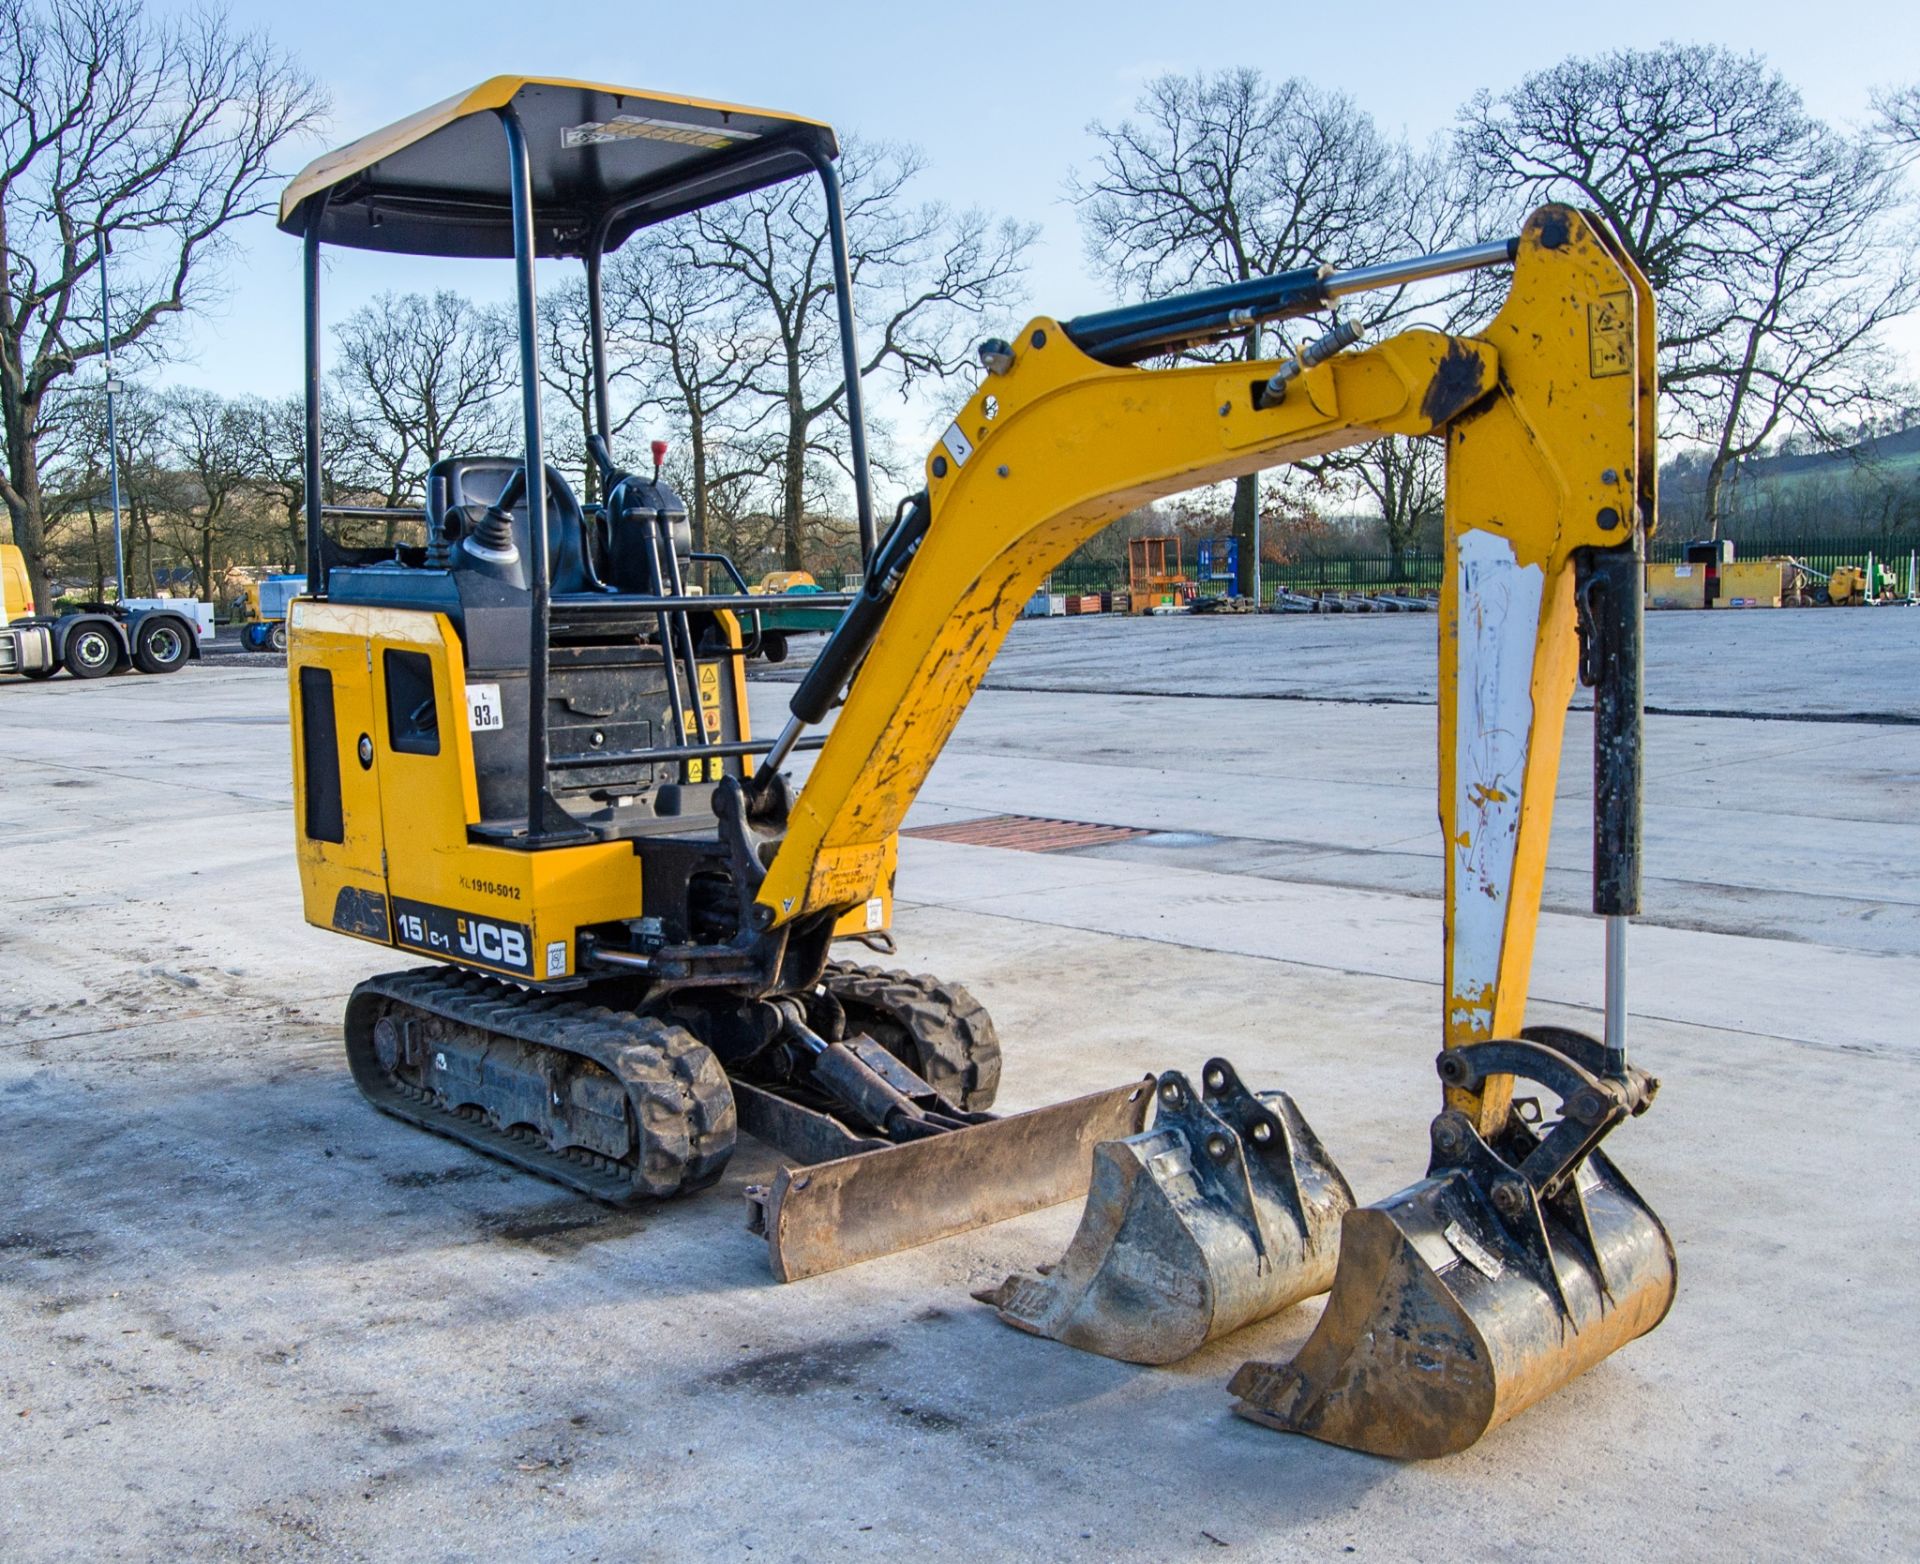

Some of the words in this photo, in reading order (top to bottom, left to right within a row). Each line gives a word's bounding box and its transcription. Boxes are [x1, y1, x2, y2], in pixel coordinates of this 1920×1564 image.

[474, 705, 491, 726] 93
[398, 914, 423, 941] 15
[457, 919, 528, 967] JCB
